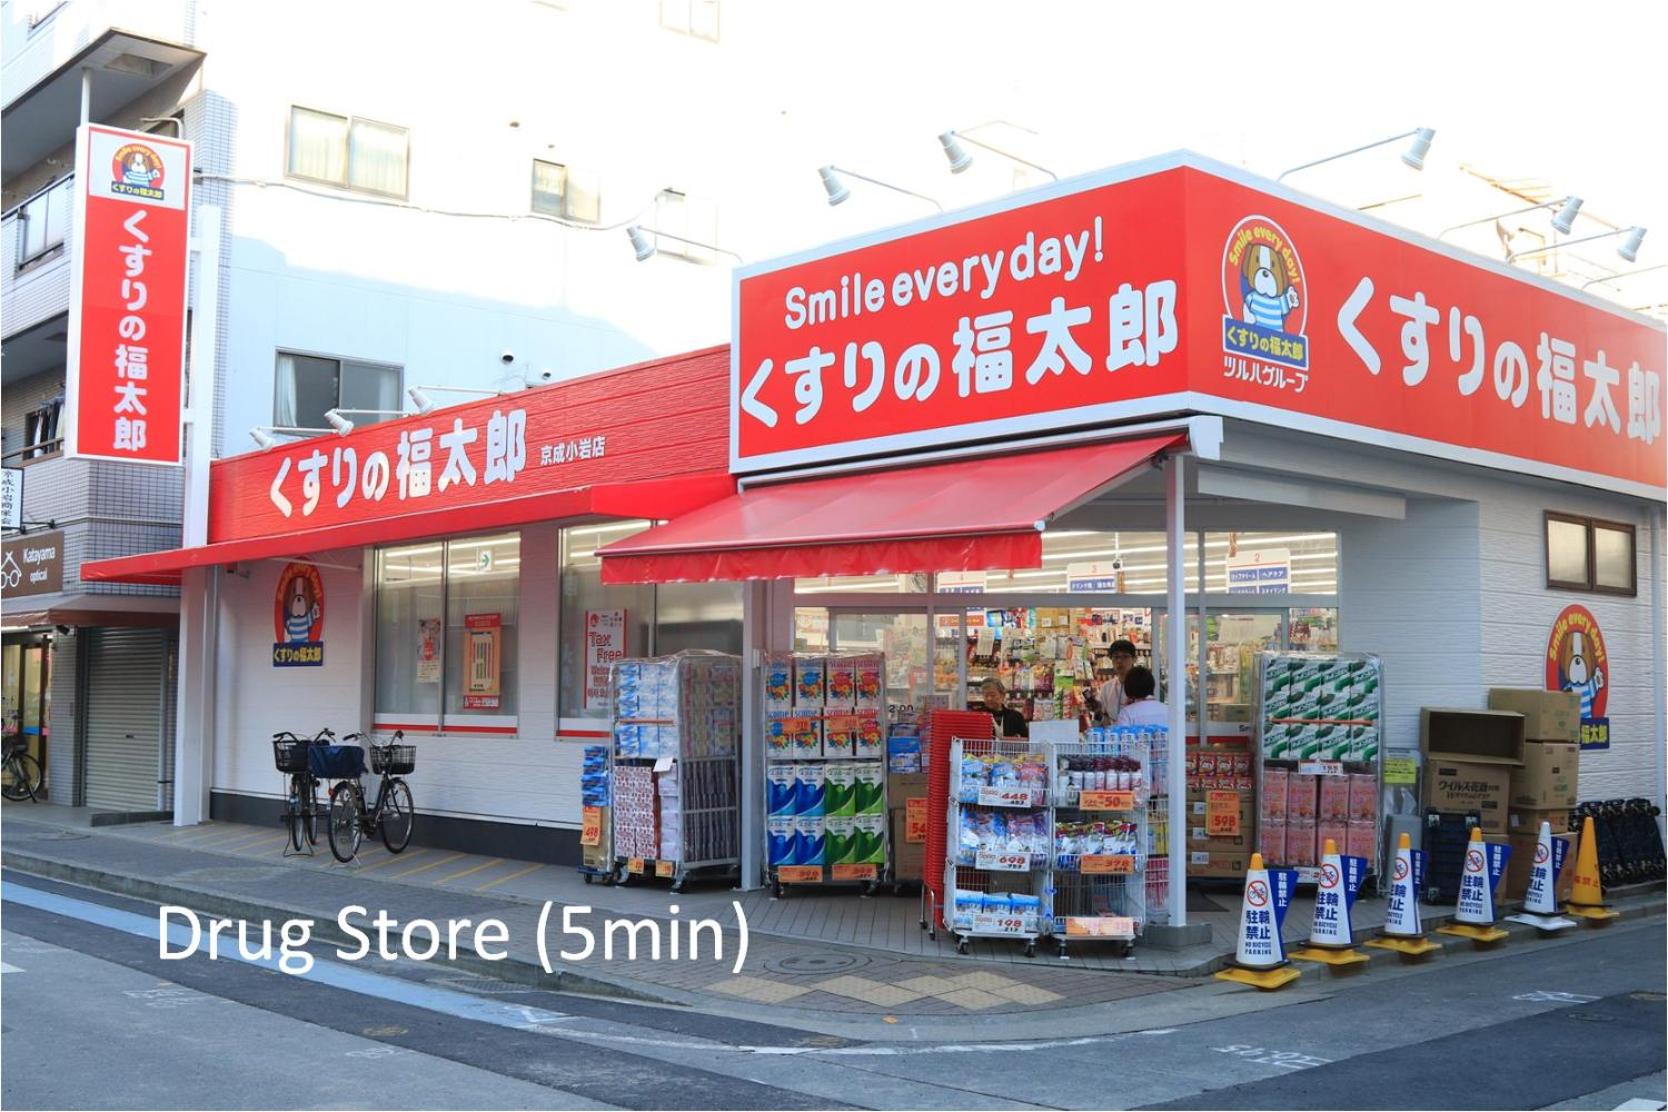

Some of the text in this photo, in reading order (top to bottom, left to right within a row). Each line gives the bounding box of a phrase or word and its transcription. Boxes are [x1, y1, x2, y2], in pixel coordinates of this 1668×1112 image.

[1228, 226, 1301, 284] Smile every day!
[785, 216, 1104, 330] Smile every day!
[113, 210, 152, 452] くすりの福太郎
[1227, 326, 1304, 361] くすりの福太郎
[741, 279, 1178, 428] くすりの福太郎
[1337, 276, 1660, 445] くすりの福太郎
[1223, 356, 1309, 392] ツルハグループ
[540, 436, 606, 466] 京成小岩店
[270, 409, 527, 518] くすりの福太郎
[23, 547, 56, 565] Katayama
[30, 568, 48, 583] optical
[589, 632, 612, 647] Tax
[1550, 613, 1605, 663] Smile every day!
[274, 647, 322, 662] くすりの福太郎
[597, 648, 622, 663] Free
[1581, 725, 1607, 743] 福太郎
[1001, 792, 1029, 801] 448
[1104, 796, 1120, 807] 50
[912, 822, 926, 834] 54
[1214, 815, 1236, 827] 598
[999, 856, 1026, 865] 698
[1278, 872, 1287, 907] 駐輪禁止
[1461, 888, 1483, 902] 禁止
[1246, 910, 1270, 925] 駐輪
[1314, 906, 1339, 921] 禁止
[997, 919, 1022, 928] 198
[1246, 926, 1271, 940] 禁止
[1244, 948, 1272, 956] PARKING
